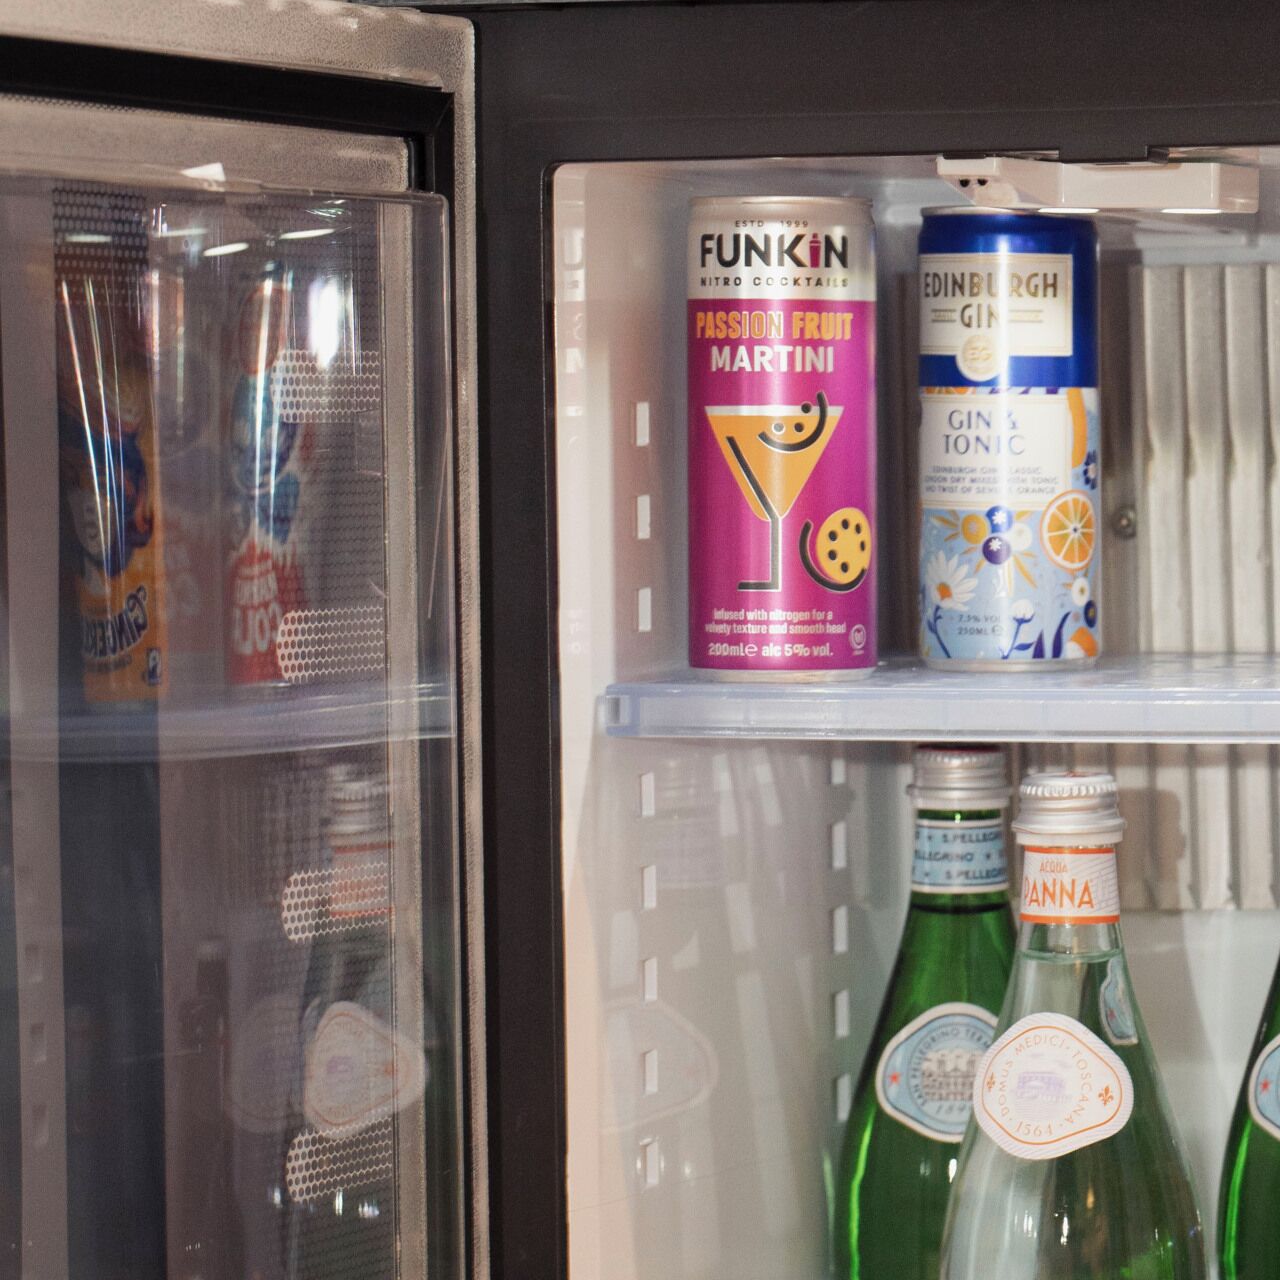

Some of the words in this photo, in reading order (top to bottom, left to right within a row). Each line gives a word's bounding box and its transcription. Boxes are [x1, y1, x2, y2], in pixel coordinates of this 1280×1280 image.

[700, 276, 742, 287] NITRO
[753, 276, 849, 288] COCKTAILS
[696, 311, 784, 340] PASSION
[792, 311, 854, 340] FRUIT
[711, 345, 834, 373] MARTINI
[948, 410, 992, 431] GIN
[943, 434, 1025, 455] TONIC
[746, 608, 768, 621] with
[812, 609, 825, 621] for
[733, 623, 767, 635] texture
[789, 622, 825, 635] smooth
[826, 622, 847, 634] head
[762, 643, 781, 657] alc
[784, 643, 810, 657] 5%
[999, 1060, 1014, 1118] DOMUS
[1015, 1034, 1066, 1056] MEDICI
[1064, 1049, 1093, 1124] TOSCANA
